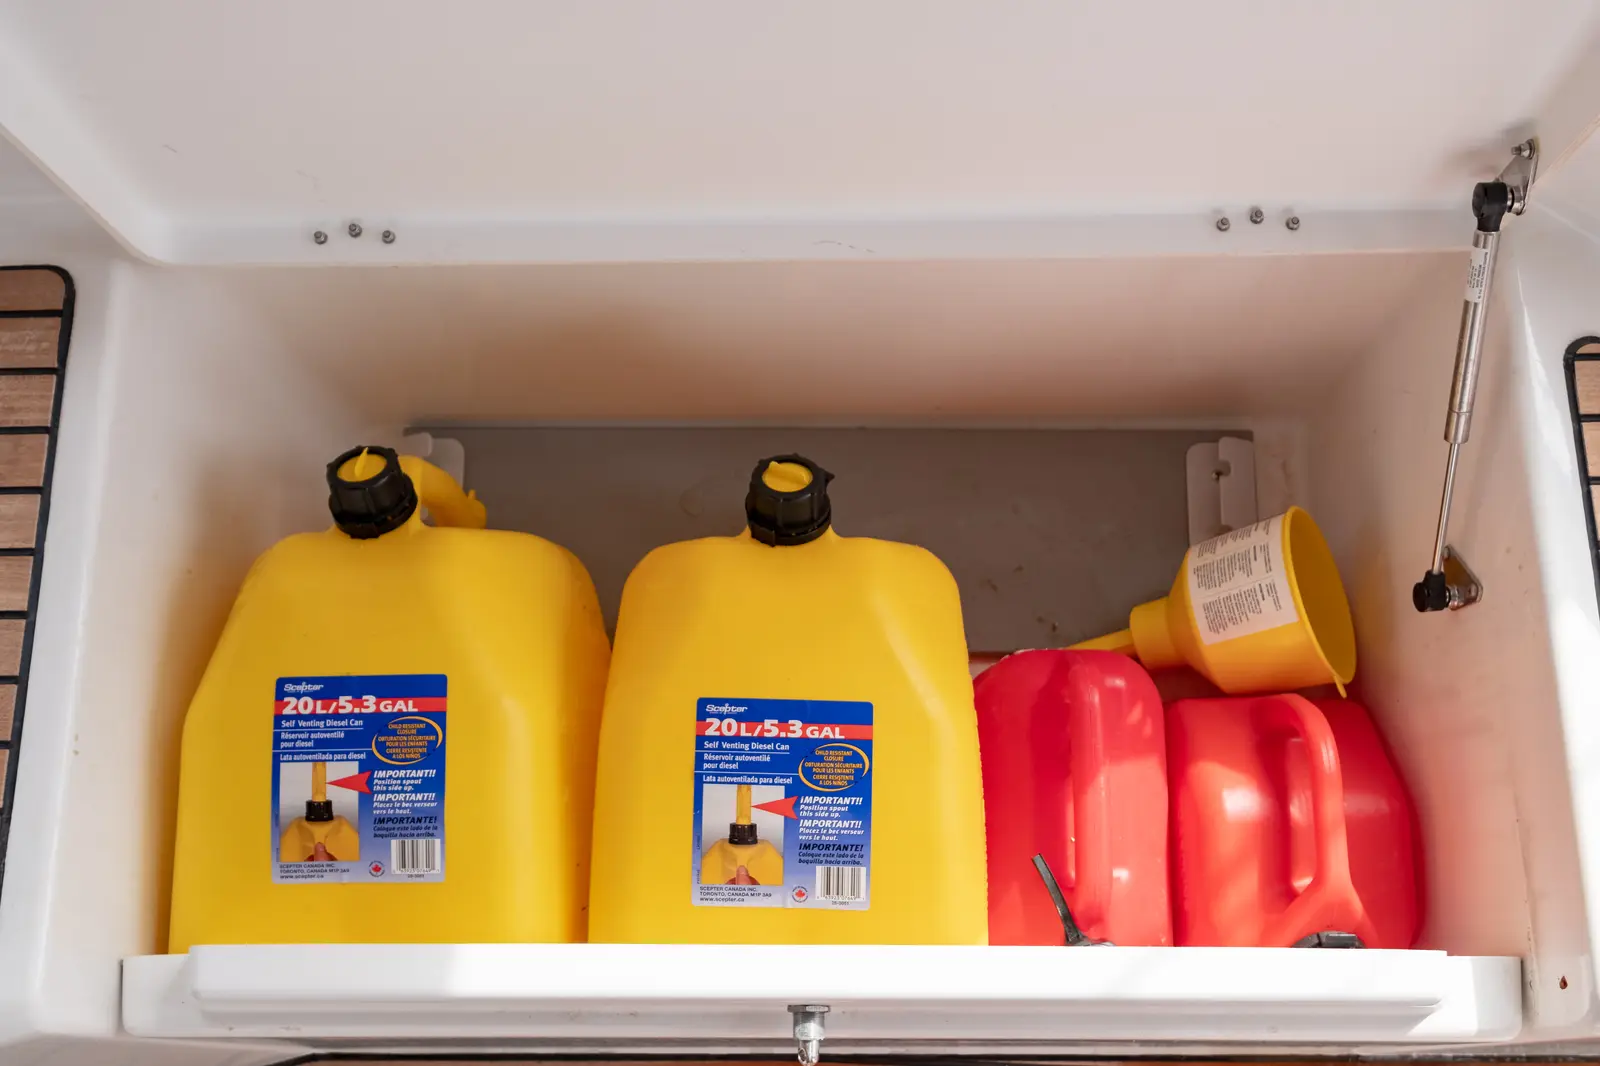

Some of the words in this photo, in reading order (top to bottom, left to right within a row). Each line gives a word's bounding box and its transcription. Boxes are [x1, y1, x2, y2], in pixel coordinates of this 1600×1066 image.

[284, 682, 324, 694] Scepter
[380, 700, 418, 712] GAL
[706, 703, 748, 714] Scepter
[298, 720, 324, 728] Venting
[806, 726, 845, 738] GAL
[722, 742, 749, 750] Venting
[374, 770, 436, 778] IMPORTANT!!
[374, 793, 436, 801] IMPORTANT!!
[800, 796, 863, 805] IMPORTANT!!
[373, 816, 437, 824] IMPORTANTE!
[799, 820, 862, 828] IMPORTANT!!
[799, 843, 864, 851] IMPORTANTE!
